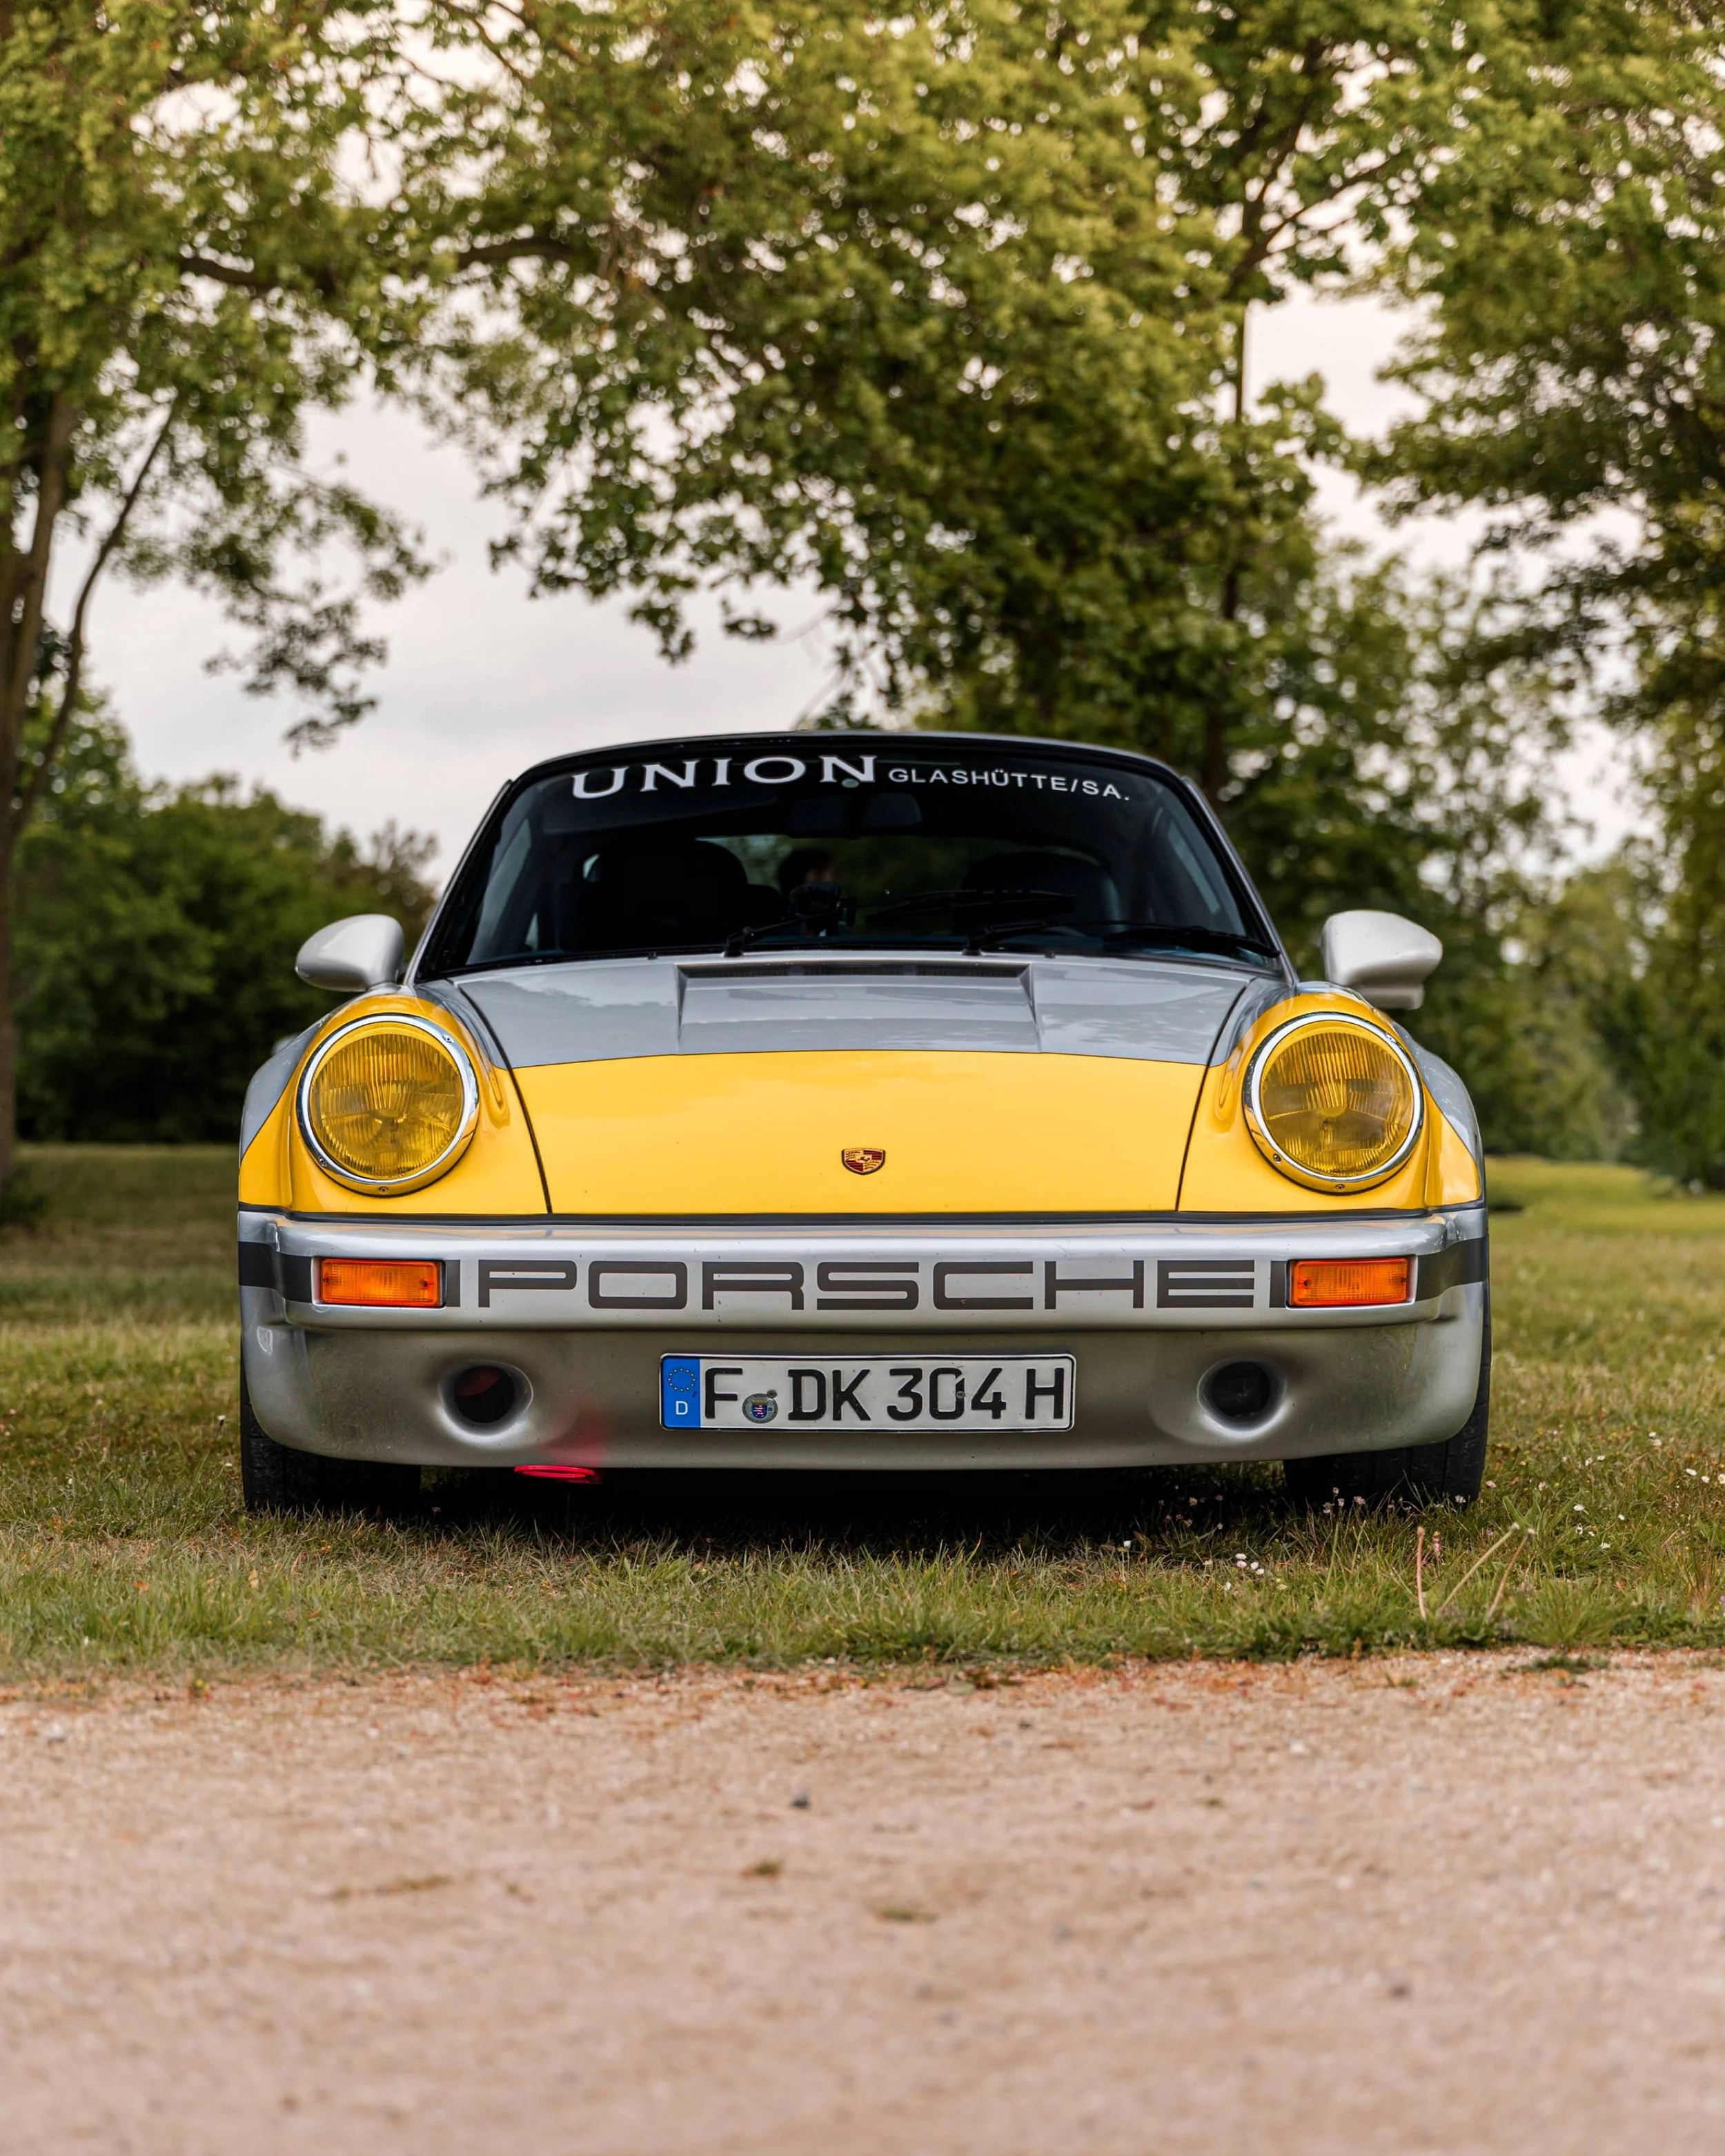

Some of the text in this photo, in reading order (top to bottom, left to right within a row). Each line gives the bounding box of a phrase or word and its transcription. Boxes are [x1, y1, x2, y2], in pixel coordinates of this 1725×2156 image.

[572, 755, 1131, 801] UNION GLASHÜTTE/SA.
[478, 1259, 1255, 1310] PORSCHE
[675, 1401, 689, 1416] D
[704, 1367, 743, 1419] F
[787, 1368, 871, 1421] DK
[887, 1367, 1007, 1421] 304
[1025, 1367, 1065, 1421] H
